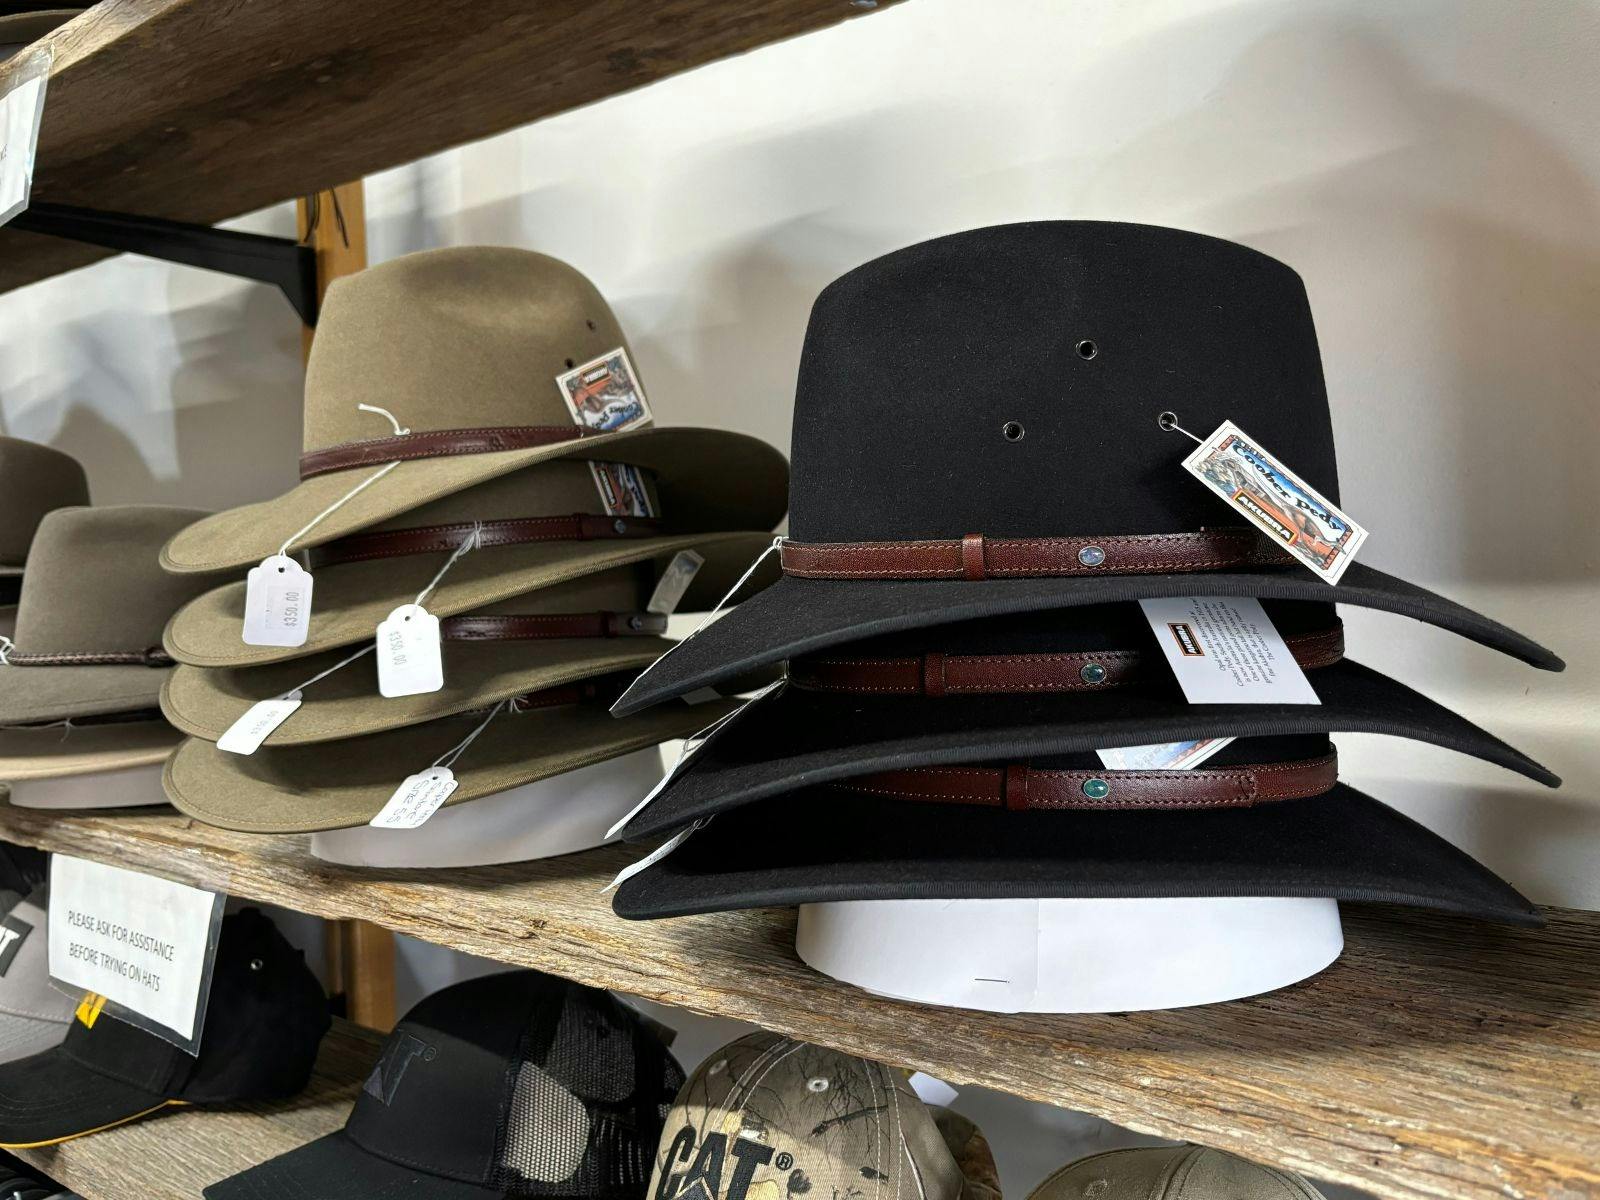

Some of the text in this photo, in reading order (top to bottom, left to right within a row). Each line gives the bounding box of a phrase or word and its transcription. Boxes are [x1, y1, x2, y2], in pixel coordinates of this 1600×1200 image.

[1233, 444, 1342, 530] Coober Pedy
[1237, 495, 1291, 540] AKUBRA
[285, 592, 300, 627] $350.00
[1174, 625, 1197, 652] AKUBRA
[68, 910, 174, 961] PLEASE ASK FOR ASSISTANCE
[69, 942, 160, 992] BEFORE TRYING ON HATS
